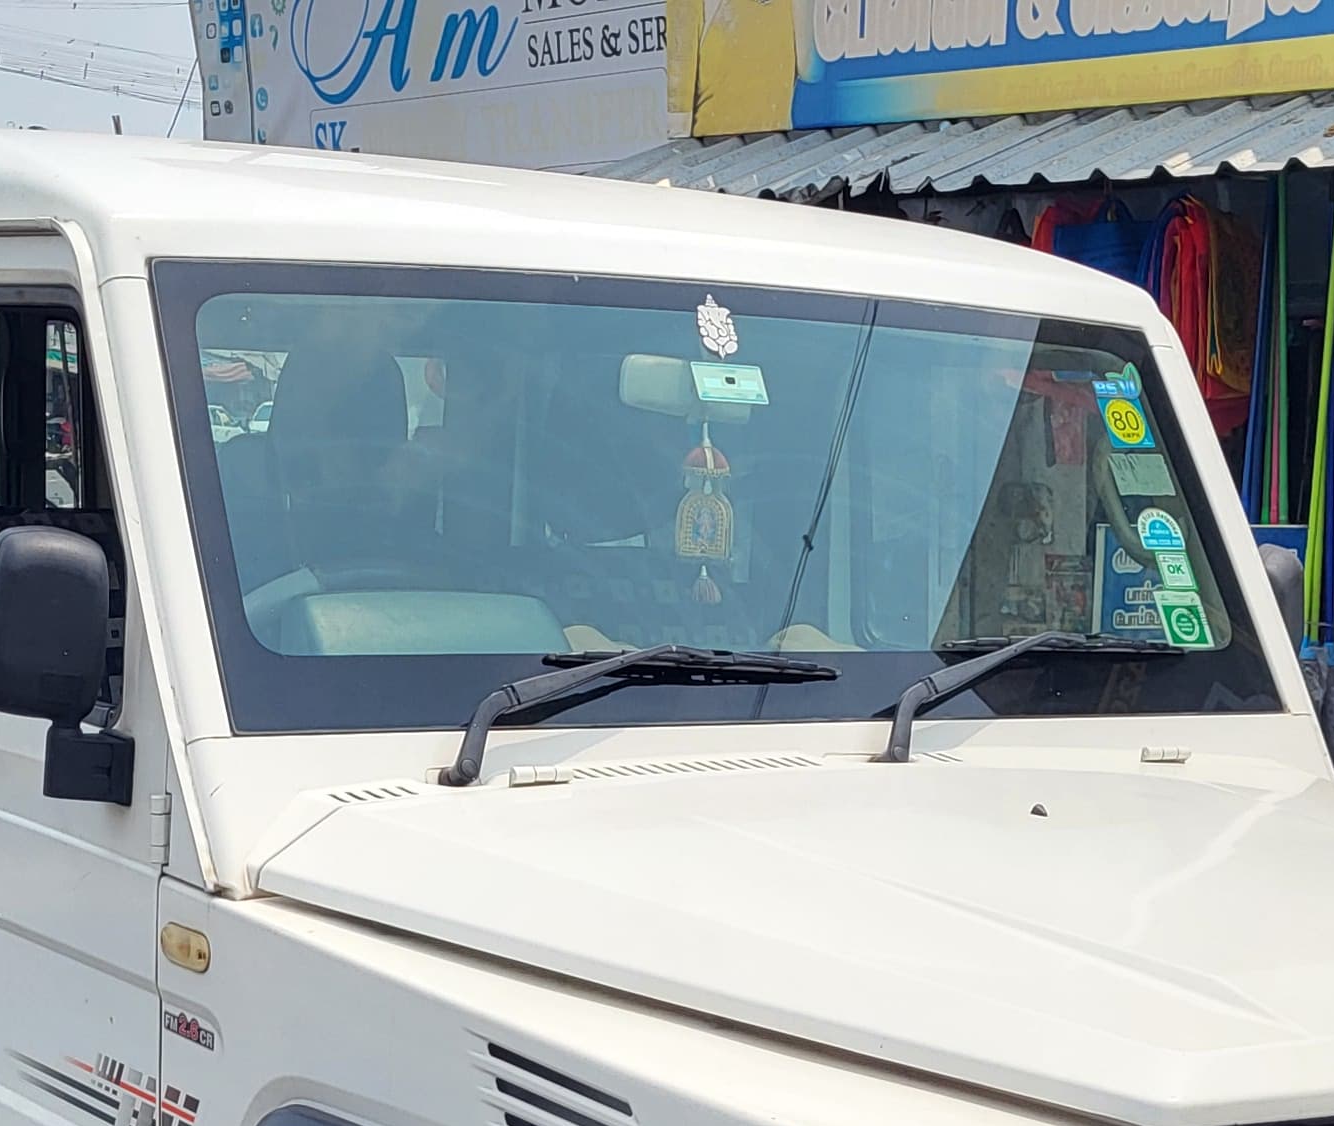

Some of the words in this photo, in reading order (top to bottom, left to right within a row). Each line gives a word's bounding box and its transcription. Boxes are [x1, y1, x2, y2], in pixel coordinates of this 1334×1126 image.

[528, 26, 595, 68] SALES
[601, 24, 622, 58] &
[1111, 410, 1140, 431] 80
[1167, 564, 1185, 575] OK
